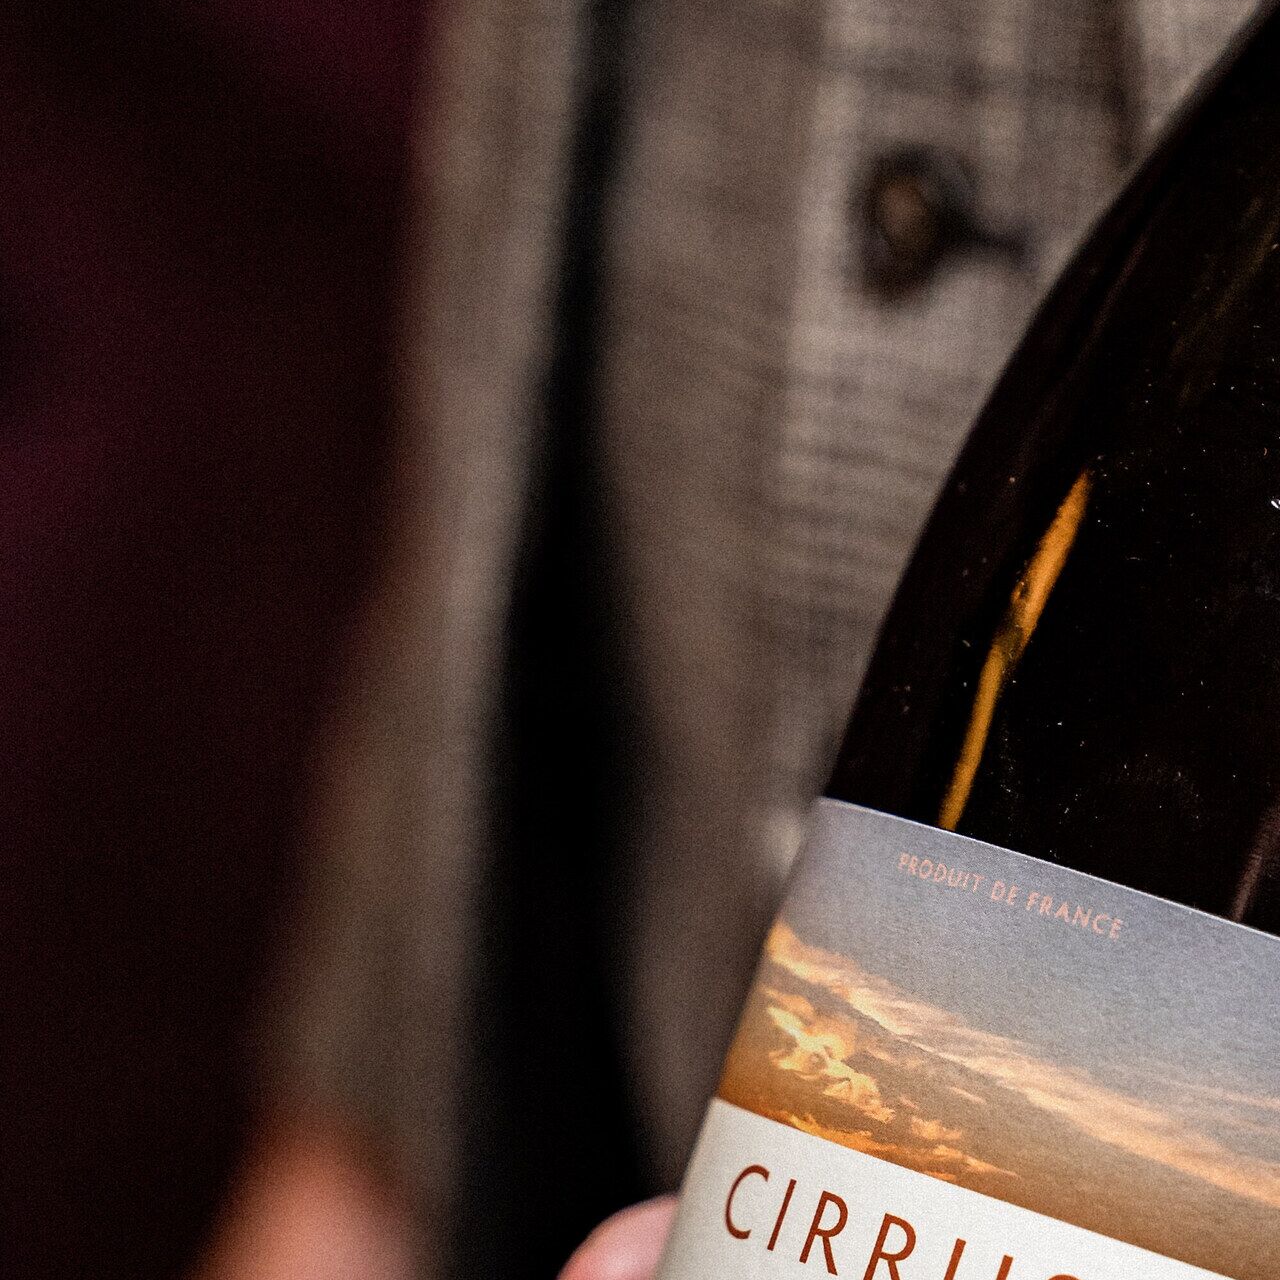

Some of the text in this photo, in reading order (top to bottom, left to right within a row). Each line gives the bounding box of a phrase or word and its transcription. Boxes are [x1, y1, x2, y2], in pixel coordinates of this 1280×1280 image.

[898, 851, 1124, 942] PRODUIT DE FRANCE
